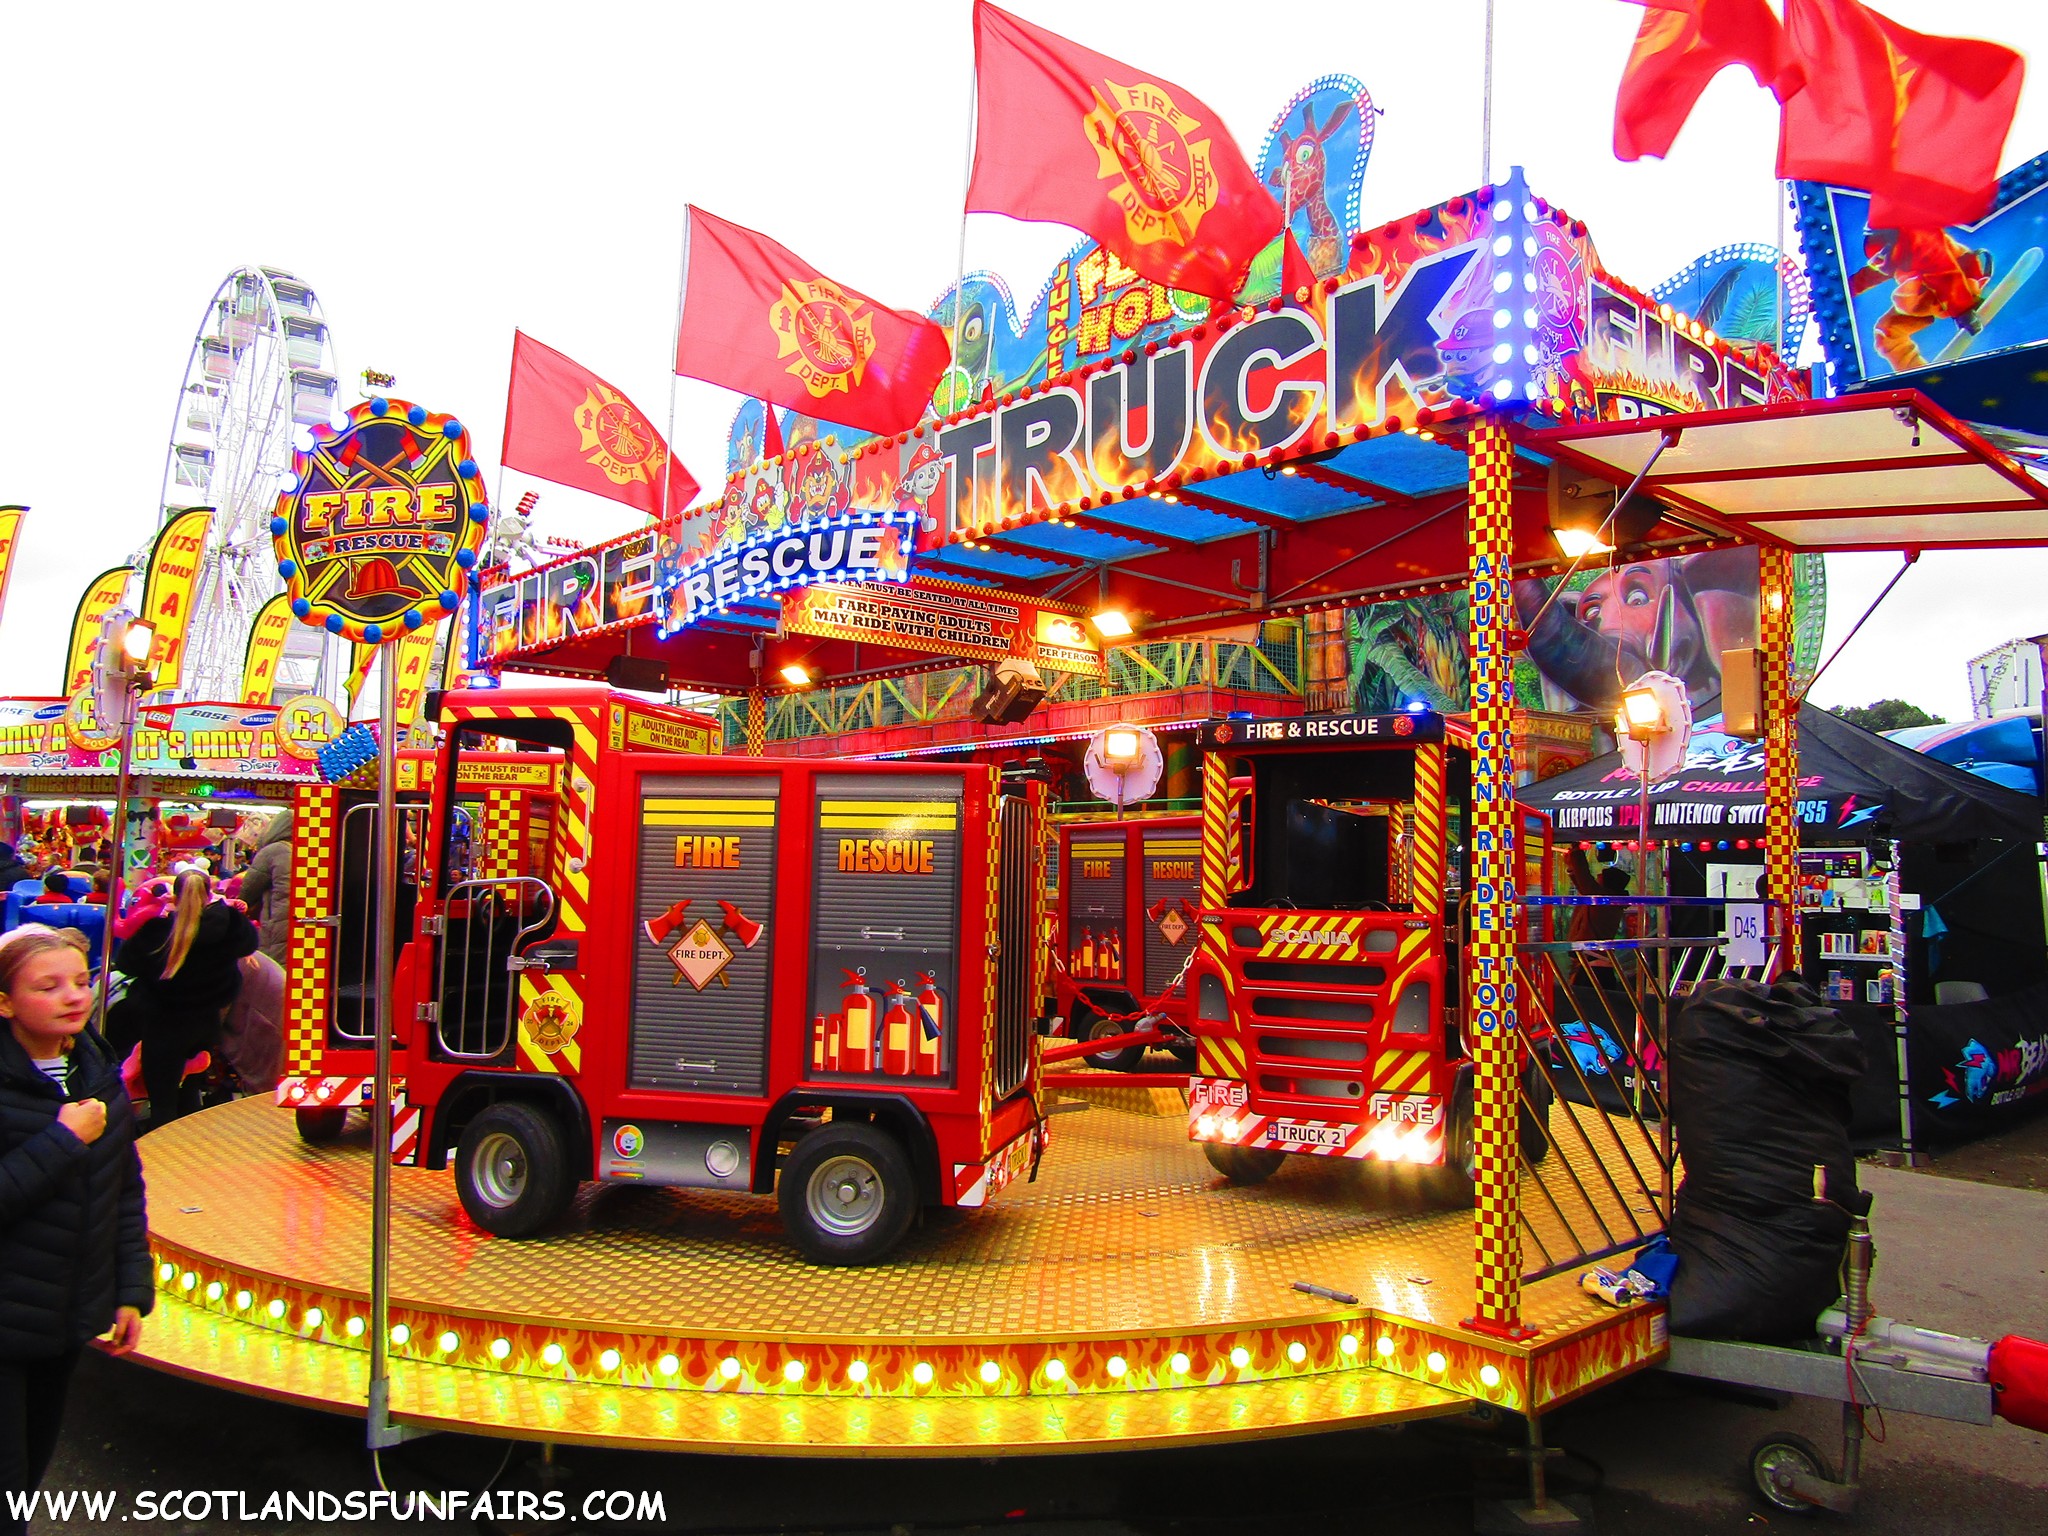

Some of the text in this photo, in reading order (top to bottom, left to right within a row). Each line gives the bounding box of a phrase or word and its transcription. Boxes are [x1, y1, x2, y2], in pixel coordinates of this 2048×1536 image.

[1128, 89, 1182, 125] FIRE
[1123, 191, 1172, 236] DEPT.
[1545, 230, 1561, 248] FIRE
[807, 283, 848, 308] FIRE
[1587, 276, 1769, 409] FIRE
[799, 363, 840, 389] DEPT.
[934, 238, 1489, 534] TRUCK
[599, 455, 639, 478] DEPT.
[303, 482, 457, 532] FIRE
[170, 535, 200, 552] ITS
[334, 534, 423, 554] RESCUE
[160, 562, 193, 579] ONLY
[683, 528, 886, 613] RESCUE
[94, 591, 120, 604] ITS
[160, 593, 179, 617] A
[479, 530, 658, 661] FIRE
[865, 584, 895, 594] MUST
[897, 587, 912, 597] BE
[914, 591, 952, 604] SEATED
[954, 598, 968, 607] AT
[968, 600, 987, 611] ALL
[988, 603, 1019, 616] TIMES
[264, 614, 288, 628] ITS
[837, 598, 991, 632] FARE PAYING ADULTS
[406, 635, 432, 645] ONLY
[813, 609, 1011, 649] MAY RIDE WITH CHILDREN
[1052, 618, 1086, 643] 3
[152, 634, 180, 663] £1
[257, 637, 281, 648] ONLY
[405, 656, 420, 675] A
[1039, 647, 1098, 663] PER PERSON
[254, 658, 268, 677] A
[397, 688, 419, 710] £1
[150, 711, 172, 723] LEGO
[182, 709, 239, 722] BOSE
[290, 709, 329, 742] £1
[51, 723, 67, 751] A
[641, 718, 698, 741] ADULTS MUST RIDE
[1246, 718, 1379, 739] FIRE & RESCUE
[136, 729, 277, 760] IT'S ONLY A
[650, 732, 690, 750] ON THE REAR
[456, 772, 518, 781] ON THE REAR
[457, 764, 533, 774] ULTS MUST RIDE
[1501, 728, 1512, 801] CAN
[1473, 554, 1497, 1032] ADULTS CAN RIDE TOO
[1552, 788, 1633, 801] BOTTLE
[1681, 774, 1825, 793] CHALLEGE
[1558, 806, 1613, 829] AIRPODS
[1619, 804, 1643, 827] IPA
[1655, 803, 1722, 825] NINTENDO
[1798, 801, 1828, 823] PS5
[674, 834, 935, 874] FIRE RESCUE
[1083, 860, 1195, 879] FIRE RESCUE
[1502, 829, 1514, 928] RIDE
[1269, 928, 1352, 946] SCANIA
[1734, 915, 1757, 939] D45
[675, 949, 726, 960] FIRE DEPT.
[1504, 956, 1516, 1030] TOO
[1194, 1083, 1244, 1107] FIRE
[1375, 1099, 1434, 1124] FIRE
[1280, 1126, 1326, 1144] TRUCK
[1331, 1131, 1341, 1145] 2
